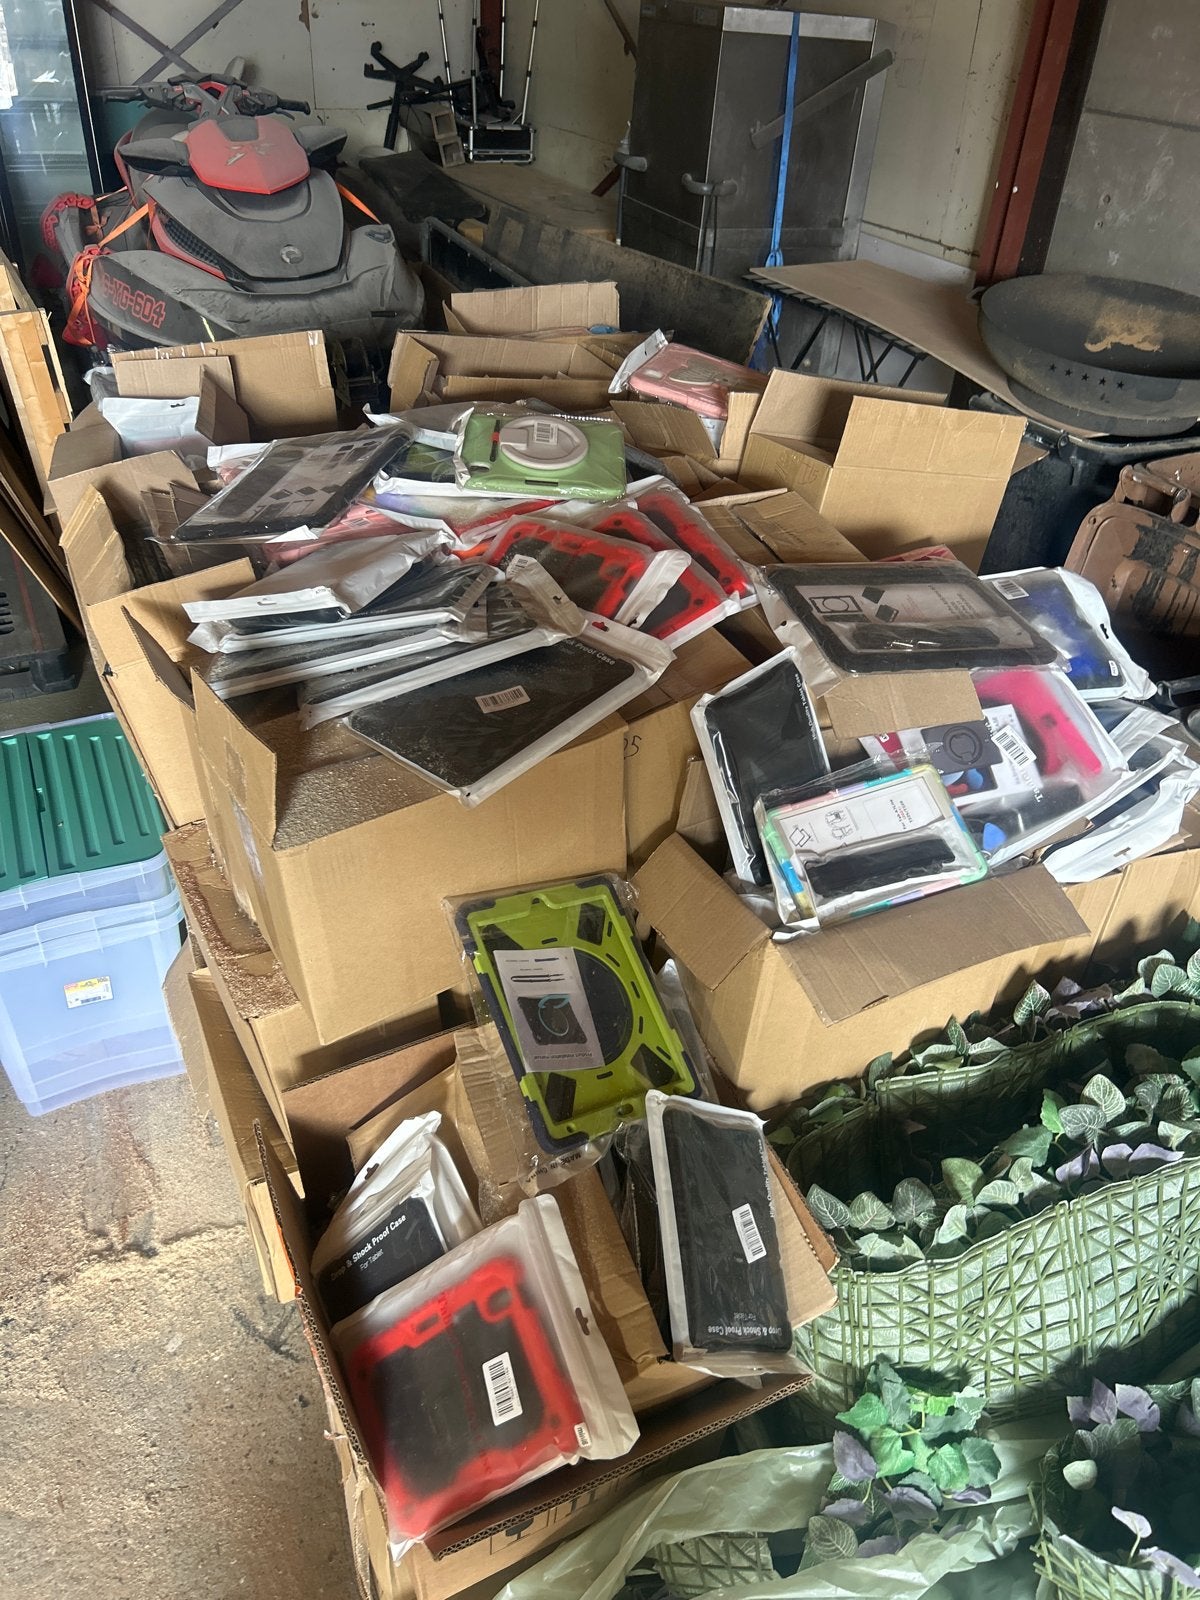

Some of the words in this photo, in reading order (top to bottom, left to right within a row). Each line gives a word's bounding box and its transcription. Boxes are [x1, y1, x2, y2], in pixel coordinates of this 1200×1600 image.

[575, 642, 597, 655] Proof
[596, 651, 616, 666] Case
[794, 673, 802, 688] Case
[799, 689, 807, 706] Tablet
[804, 705, 814, 727] Quality
[346, 1259, 353, 1268] &
[352, 1242, 373, 1263] Shock
[371, 1226, 390, 1247] Proof
[389, 1214, 407, 1231] Case
[359, 1261, 369, 1271] For
[368, 1249, 384, 1264] Tablet
[707, 1325, 724, 1336] Case
[725, 1326, 742, 1336] Proof
[743, 1326, 762, 1336] Shock
[762, 1326, 768, 1336] &
[768, 1326, 783, 1336] Drop
